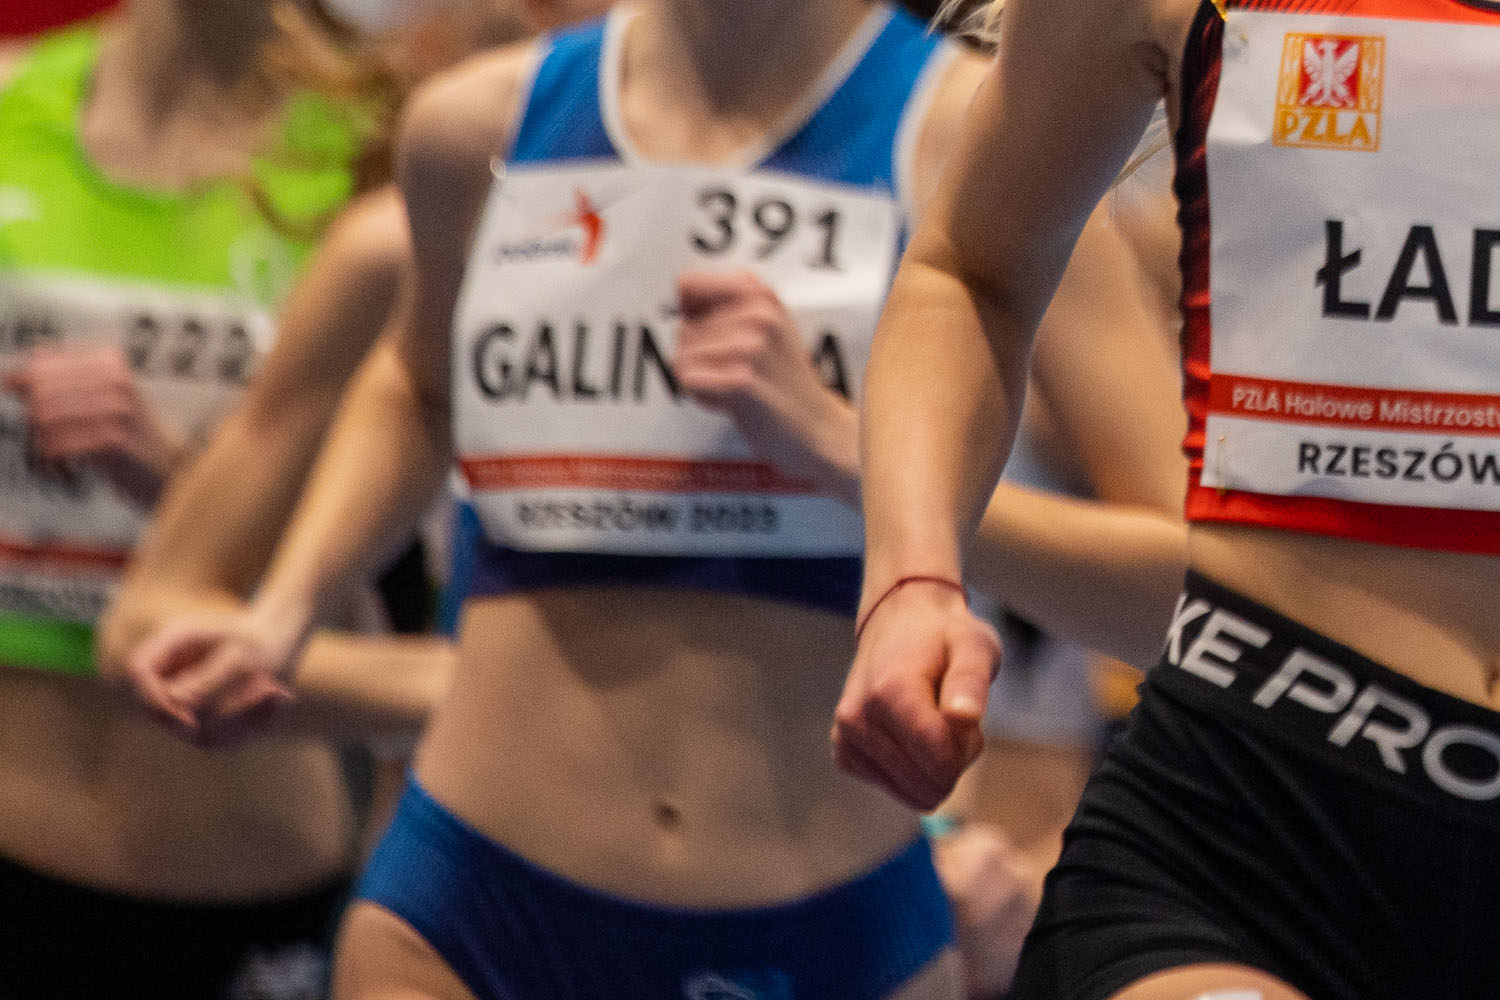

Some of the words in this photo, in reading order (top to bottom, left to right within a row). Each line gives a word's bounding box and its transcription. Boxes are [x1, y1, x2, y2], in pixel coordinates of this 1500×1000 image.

[1278, 108, 1372, 145] PZLA
[690, 187, 843, 271] 391
[1232, 386, 1280, 413] PZLA
[1285, 393, 1374, 421] Halowe
